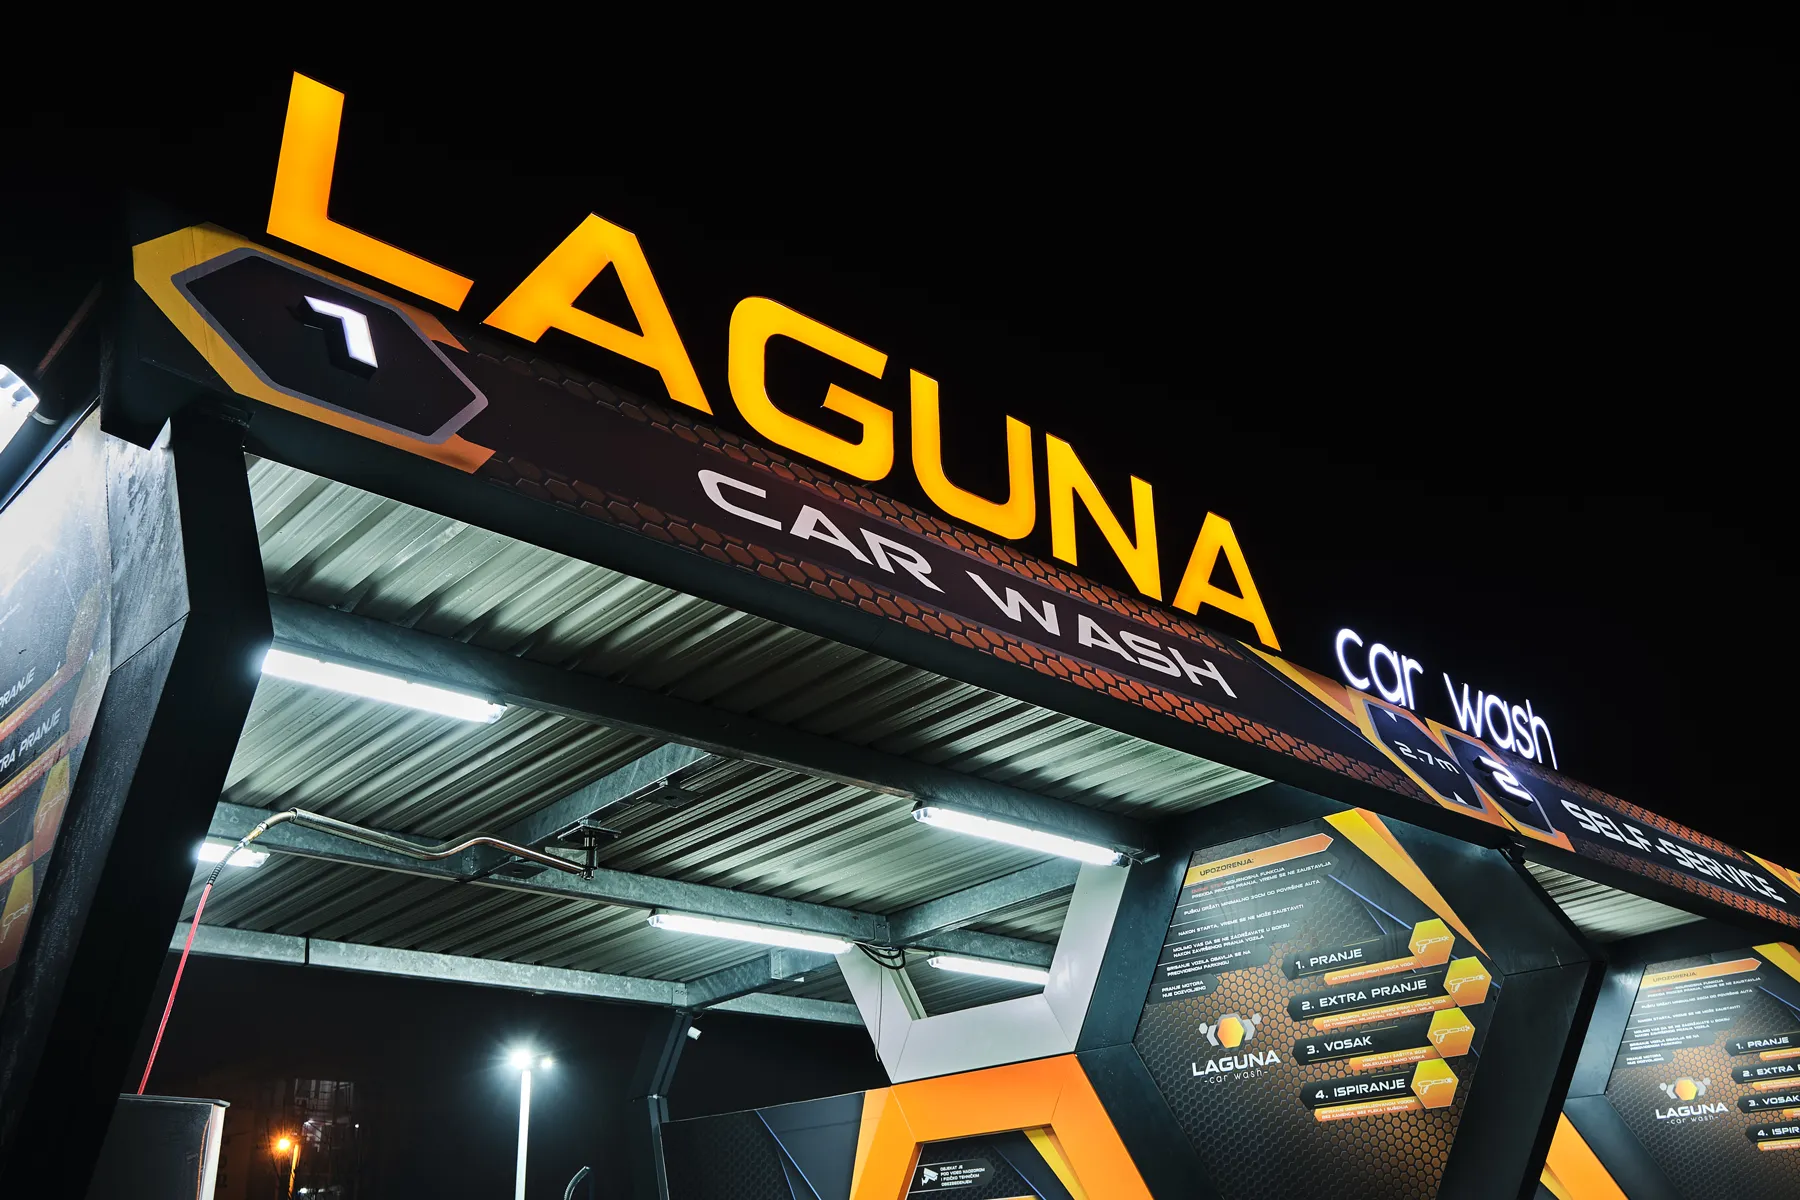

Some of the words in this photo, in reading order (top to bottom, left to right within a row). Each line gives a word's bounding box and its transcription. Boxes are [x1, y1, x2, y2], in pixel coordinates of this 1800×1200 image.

[267, 72, 1280, 650] LAGUNA
[698, 470, 944, 593] CAR
[966, 571, 1237, 698] WASH
[1336, 628, 1423, 710] car
[1443, 672, 1557, 770] wash
[19, 707, 61, 757] PRANJE
[1395, 740, 1459, 774] 2.7m
[1476, 755, 1534, 802] 2
[1200, 858, 1254, 876] UPOZORENJA:
[1305, 879, 1320, 888] AUTA
[1296, 960, 1305, 969] 1.
[1310, 948, 1362, 966] PRANJE
[1301, 1001, 1314, 1010] 2.
[1320, 992, 1367, 1008] EXTRA
[1371, 979, 1427, 998] PRANJE
[1307, 1045, 1319, 1054] 3.
[1324, 1036, 1372, 1052] VOSAK
[1748, 1037, 1789, 1048] PRANJE
[1192, 1050, 1281, 1076] LAGUNA
[1757, 1065, 1794, 1075] EXTRA
[1315, 1090, 1328, 1099] 4.
[1334, 1079, 1405, 1097] ISPIRANJE
[1655, 1102, 1728, 1119] LAGUNA
